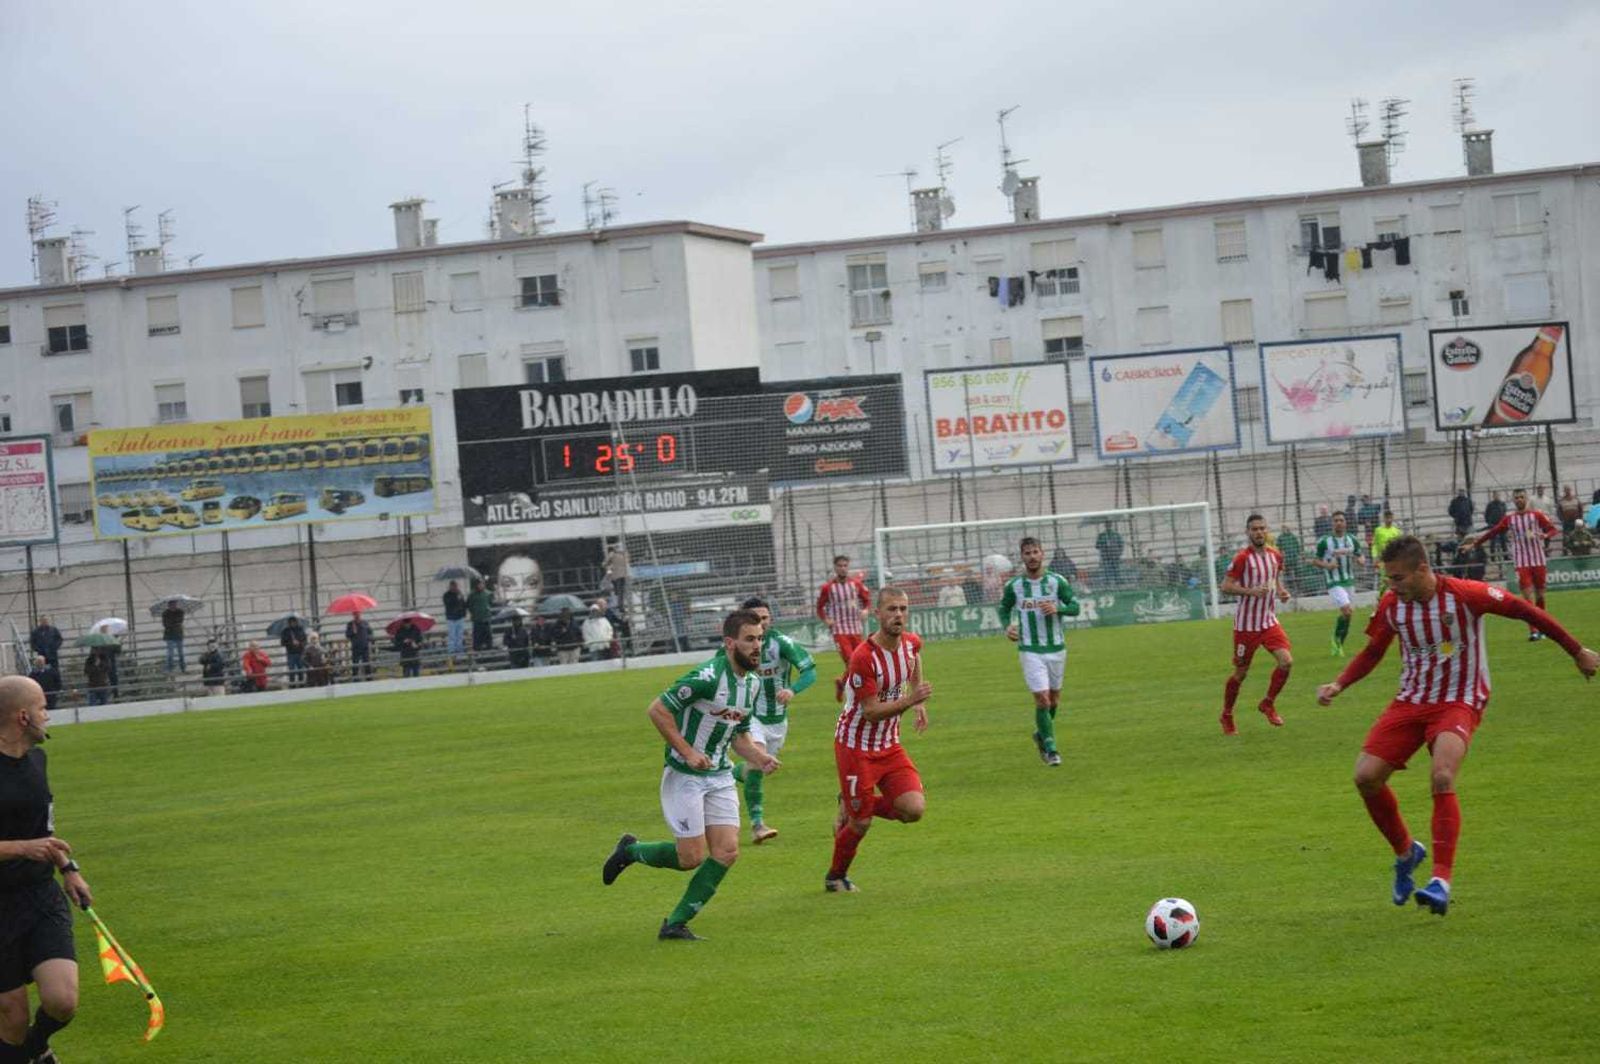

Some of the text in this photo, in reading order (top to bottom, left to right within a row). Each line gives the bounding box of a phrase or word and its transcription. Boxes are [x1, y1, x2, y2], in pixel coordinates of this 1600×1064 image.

[519, 384, 697, 430] BARBADILLO
[936, 408, 1066, 438] BARATITO
[103, 423, 316, 455] Autocares Zambrano
[563, 442, 572, 468] 1
[656, 433, 677, 464] 0
[645, 490, 687, 509] RADIO
[697, 486, 749, 506] 94.2FM
[911, 609, 957, 635] RING
[846, 774, 858, 797] 7
